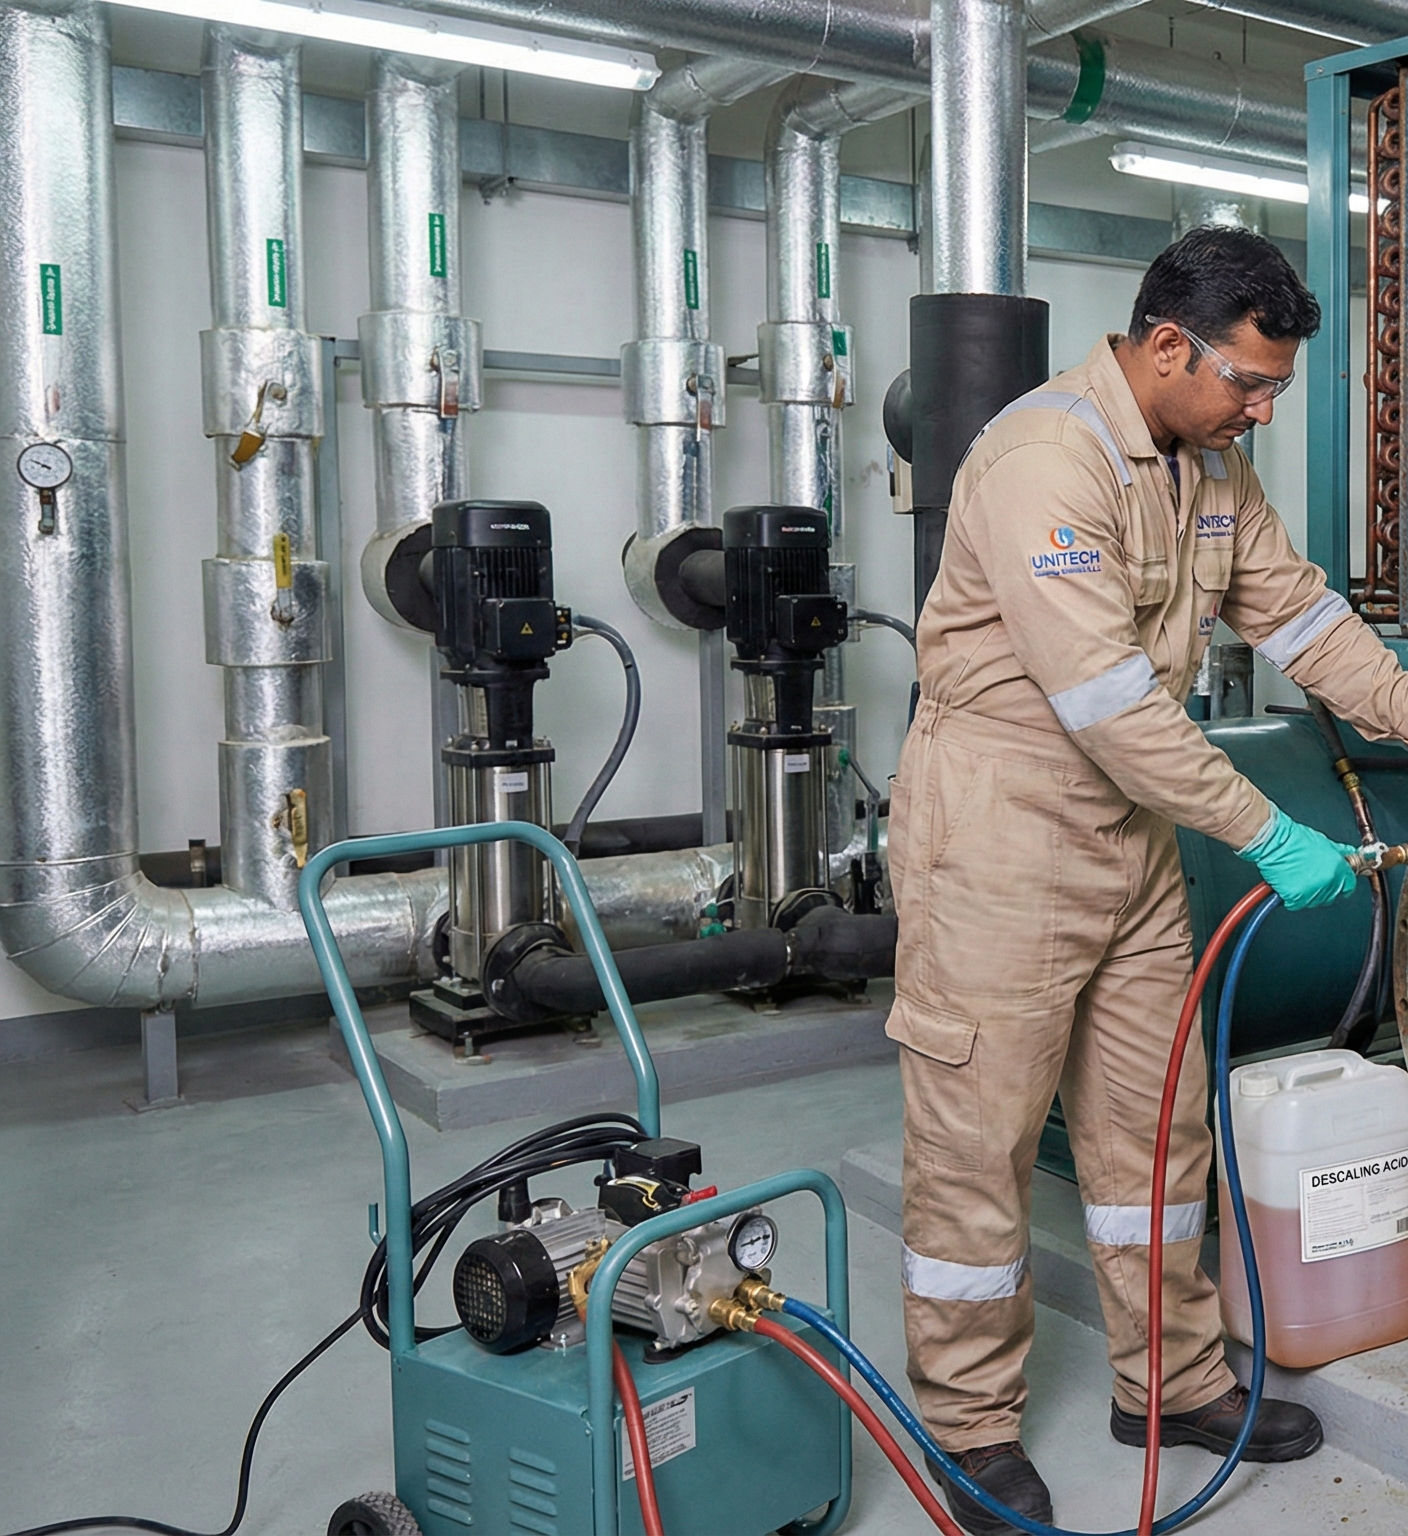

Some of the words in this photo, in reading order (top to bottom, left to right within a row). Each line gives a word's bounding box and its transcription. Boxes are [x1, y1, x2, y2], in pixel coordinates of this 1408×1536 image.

[1031, 549, 1100, 569] UNITECH
[1311, 1163, 1380, 1188] DESCALING
[1383, 1156, 1408, 1172] ACID
